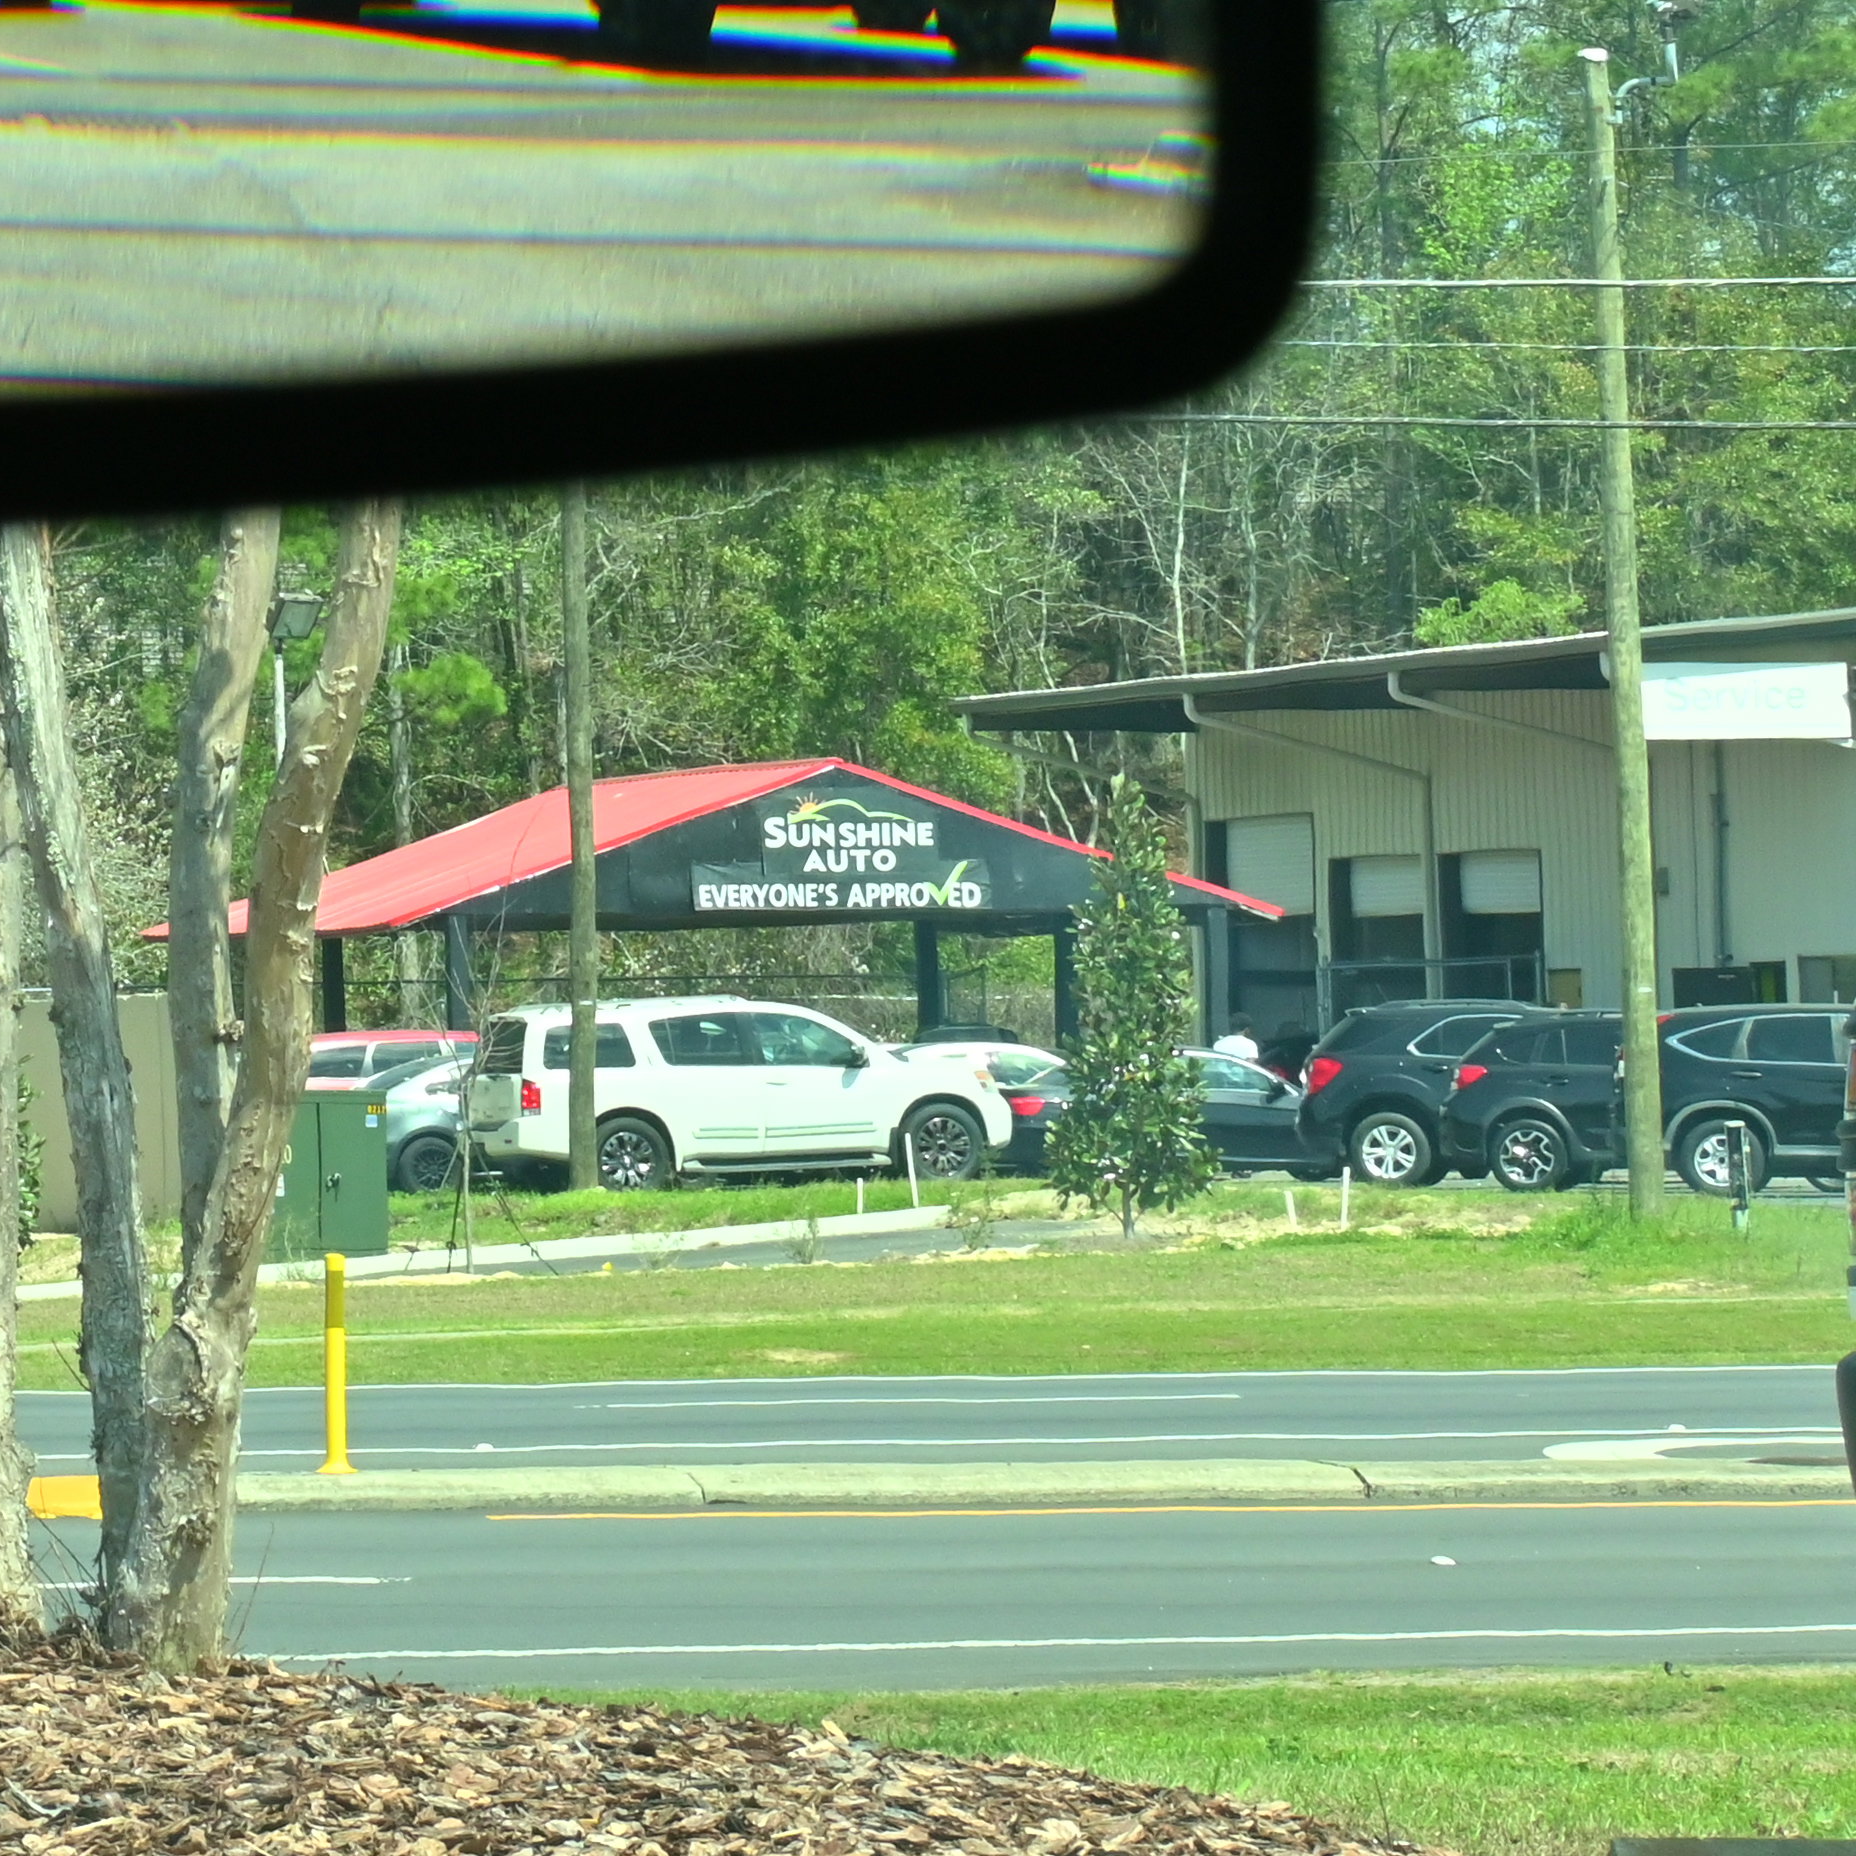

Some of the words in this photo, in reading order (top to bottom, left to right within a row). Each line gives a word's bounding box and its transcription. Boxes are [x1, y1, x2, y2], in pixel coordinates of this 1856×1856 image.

[1663, 678, 1808, 712] Service
[763, 817, 934, 849] SUNSHINE
[802, 849, 897, 873] AUTO
[698, 882, 838, 909] EVERYONE'S
